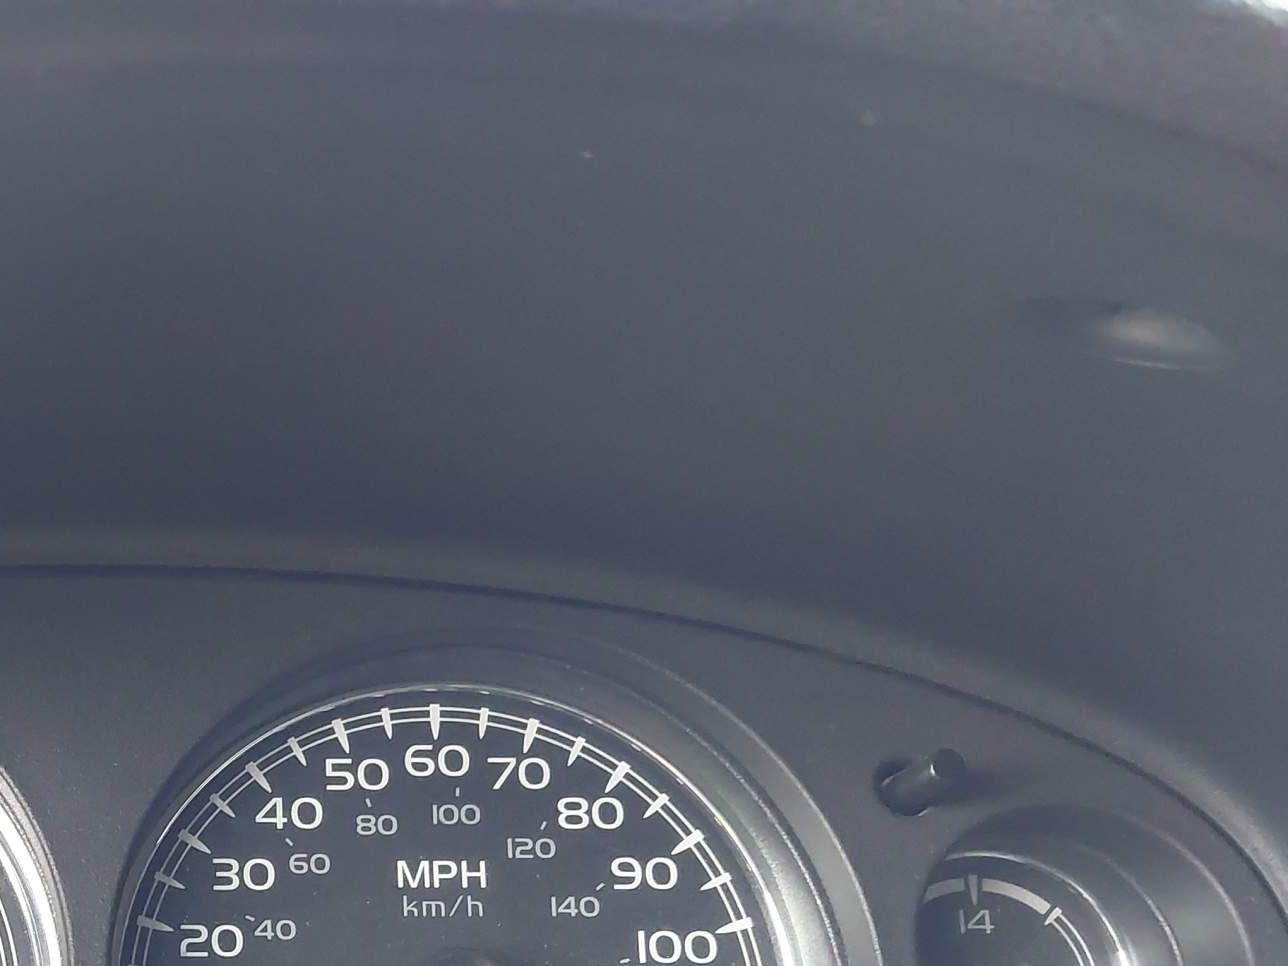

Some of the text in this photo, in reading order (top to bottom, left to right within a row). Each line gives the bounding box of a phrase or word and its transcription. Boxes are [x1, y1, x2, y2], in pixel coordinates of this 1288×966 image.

[325, 758, 390, 791] 50
[404, 744, 470, 777] 60
[487, 757, 551, 790] 70
[255, 797, 323, 830] 40
[356, 814, 398, 836] 80
[432, 804, 481, 825] 100
[557, 797, 624, 830] 80
[506, 837, 556, 859] 120
[212, 858, 276, 891] 30
[289, 853, 331, 875] 60
[396, 860, 487, 889] MPH
[610, 856, 678, 890] 90
[402, 895, 484, 917] km/h
[550, 896, 600, 918] 140
[254, 919, 298, 941] 40
[959, 909, 995, 935] 14
[180, 924, 244, 957] 20
[636, 928, 718, 965] 100
